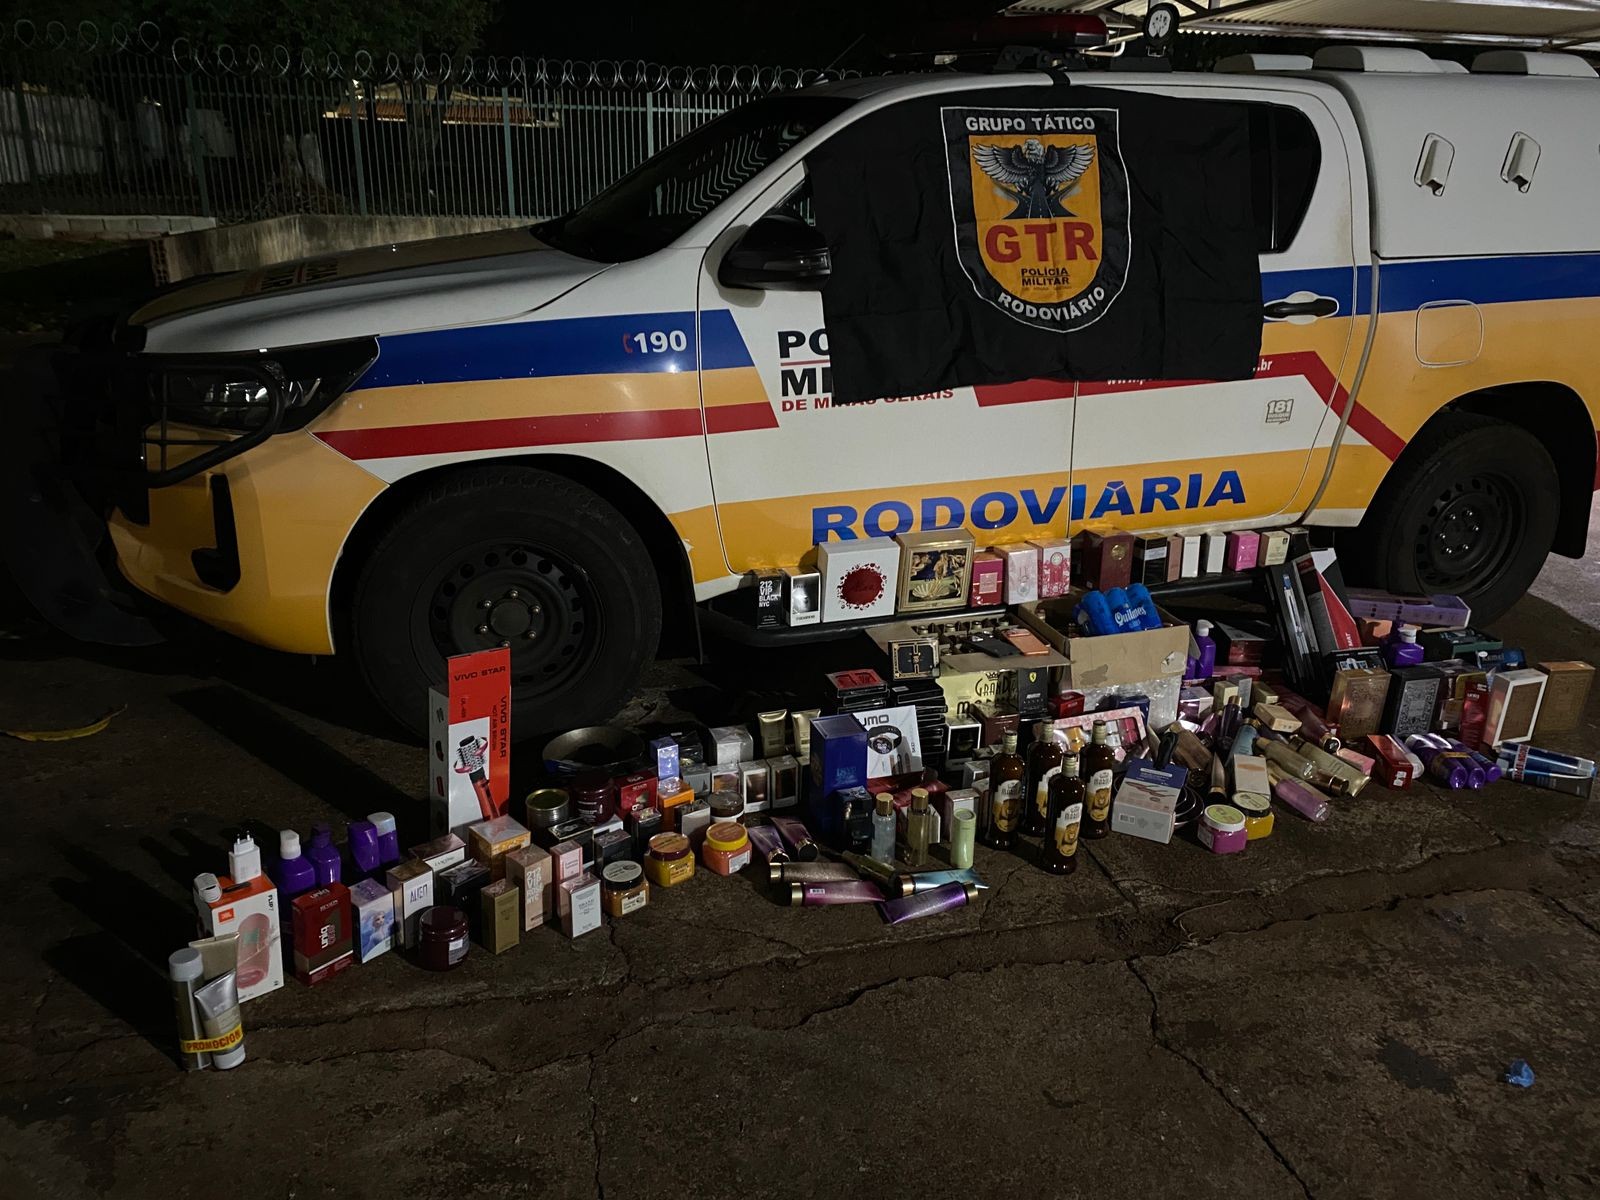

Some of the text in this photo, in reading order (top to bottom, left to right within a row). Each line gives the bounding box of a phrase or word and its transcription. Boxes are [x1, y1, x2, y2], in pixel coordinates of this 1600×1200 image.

[966, 114, 1095, 131] GRUPO TÁTICO
[985, 222, 1098, 263] GTR
[1021, 266, 1069, 276] POLÍCIA
[1022, 277, 1070, 287] MILITAR
[998, 286, 1105, 321] RODOVIÁRIO
[633, 330, 687, 353] 190
[782, 400, 807, 412] DE
[1267, 399, 1294, 415] 181
[812, 470, 1246, 545] RODOVIÁRIA
[760, 580, 773, 589] 212
[760, 588, 773, 596] VIP
[1114, 606, 1147, 627] Quilmes
[454, 665, 506, 682] VIVO STAR
[186, 1030, 241, 1052] PROMOCION
